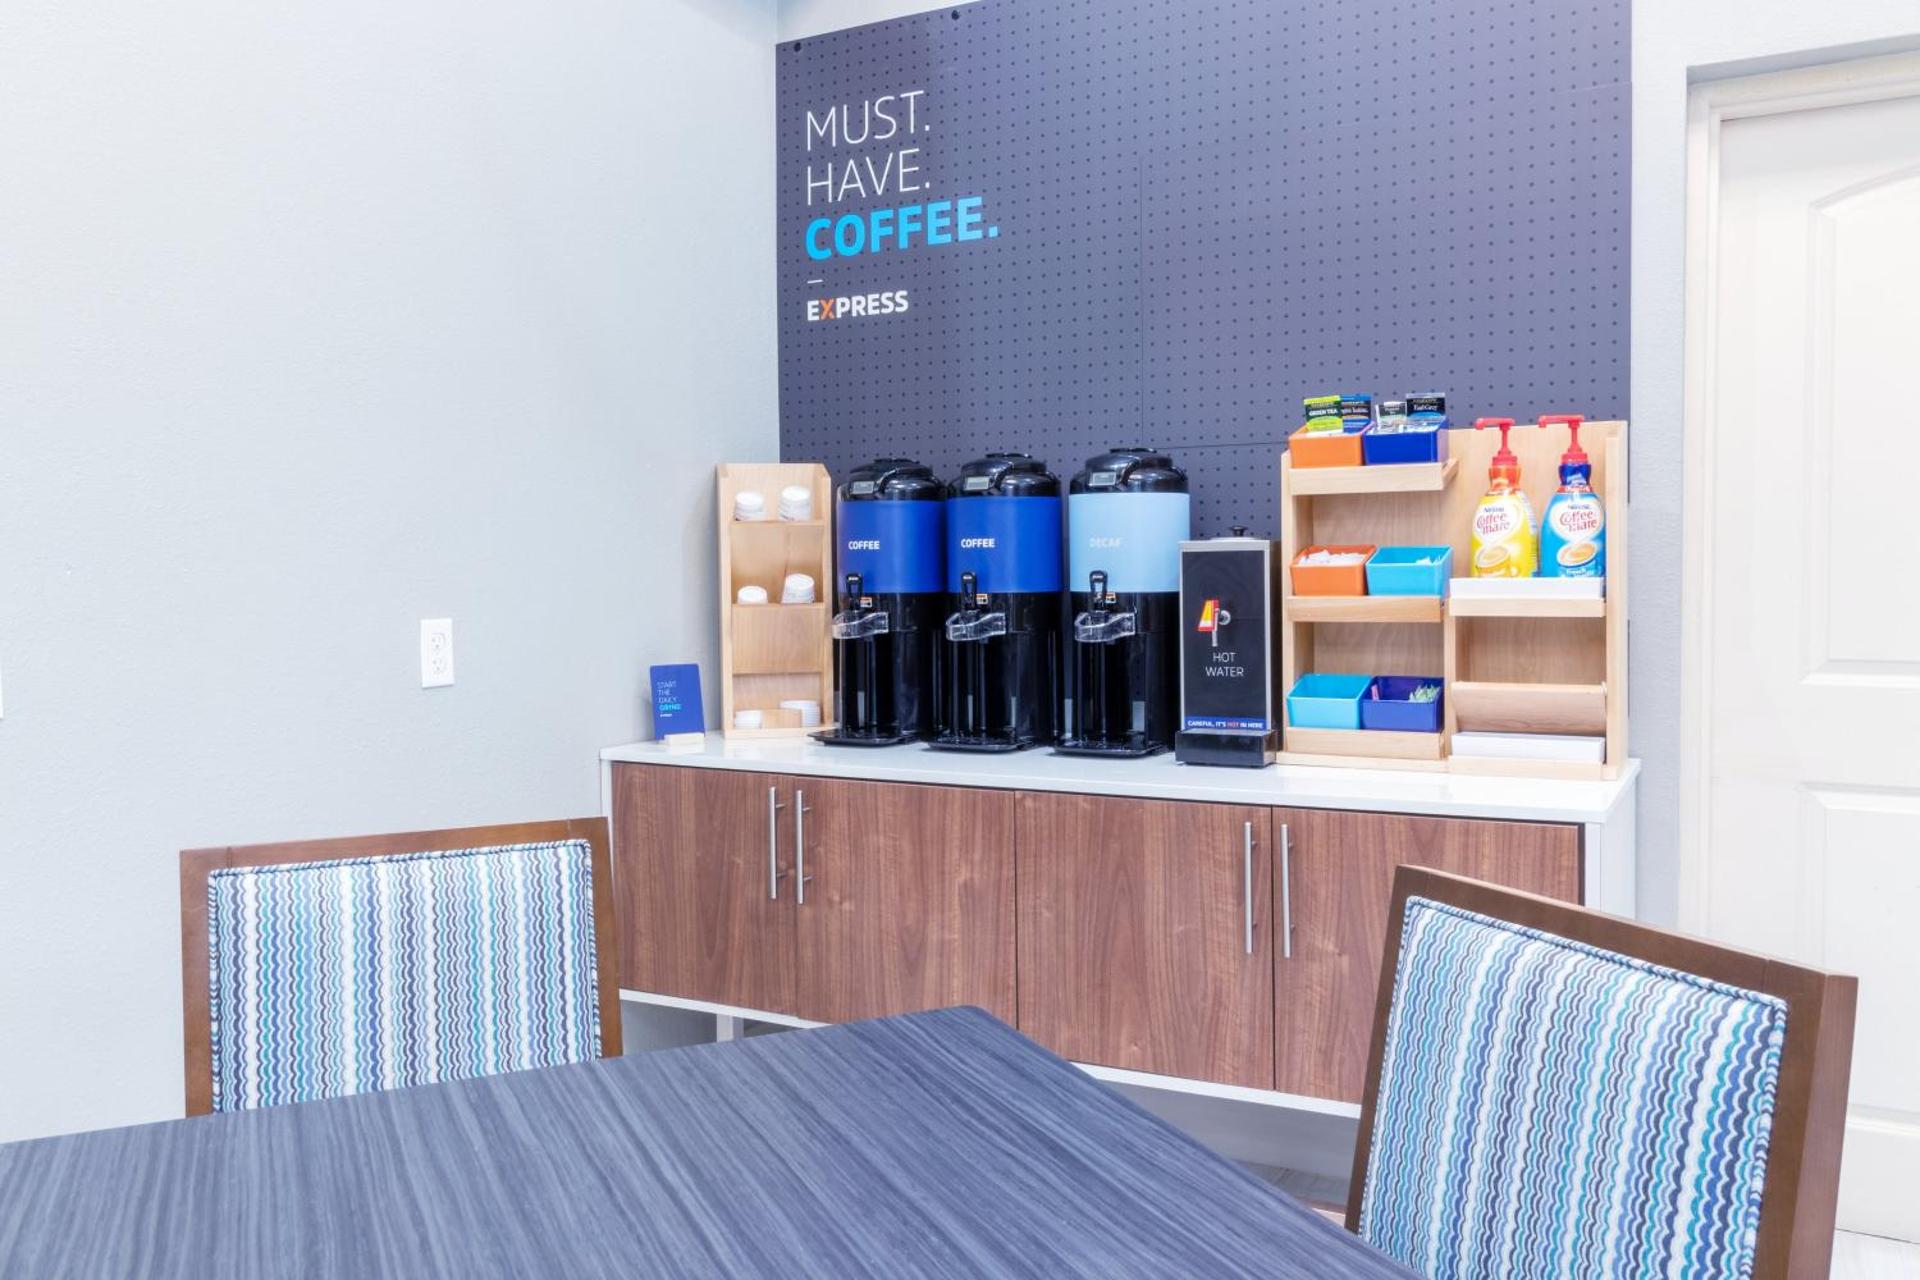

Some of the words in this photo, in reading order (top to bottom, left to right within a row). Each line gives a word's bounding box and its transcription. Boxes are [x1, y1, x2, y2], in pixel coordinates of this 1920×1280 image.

[807, 90, 930, 151] MUST.
[807, 148, 930, 206] HAVE.
[805, 196, 999, 261] COFFEE.
[807, 290, 909, 322] EXPRESS
[848, 540, 880, 550] COFFEE
[960, 538, 995, 548] COFFEE
[1089, 537, 1121, 548] DECAF
[1212, 652, 1236, 662] HOT
[1205, 666, 1244, 677] WATER
